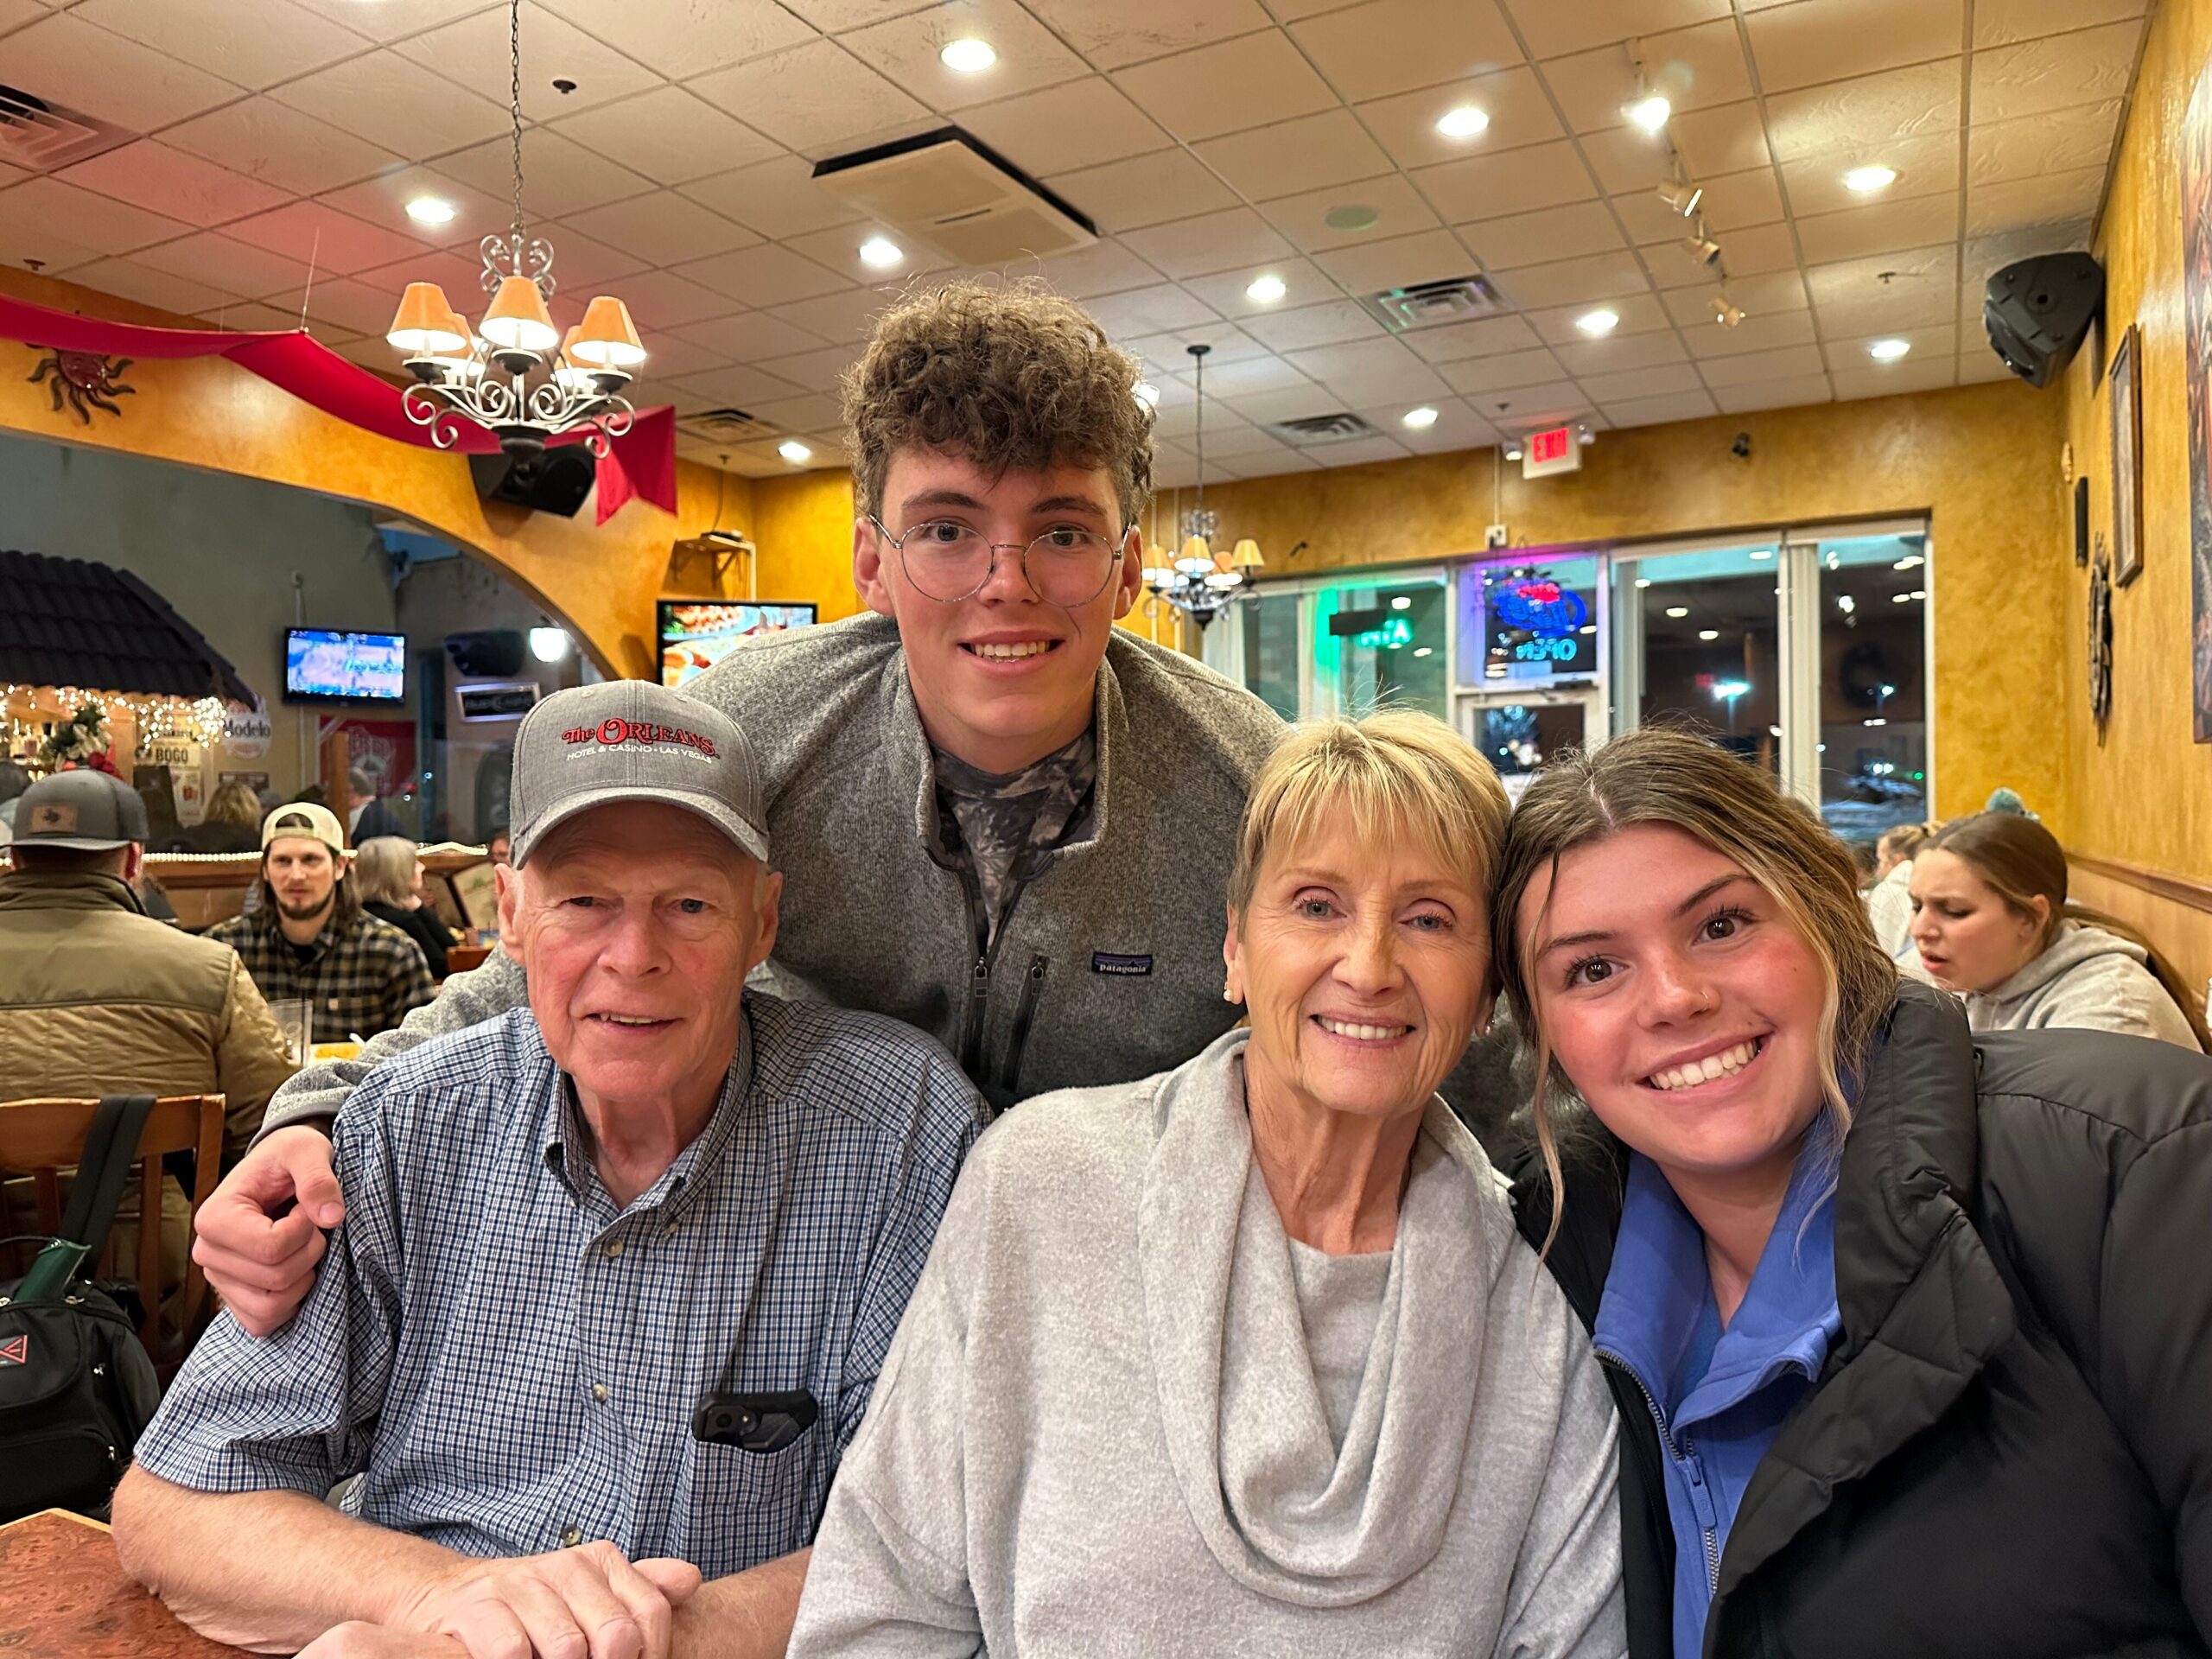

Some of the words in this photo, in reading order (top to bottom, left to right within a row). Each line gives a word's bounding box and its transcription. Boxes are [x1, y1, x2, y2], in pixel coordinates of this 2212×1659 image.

[1533, 428, 1568, 462] EXIT
[223, 719, 270, 739] Modelo
[562, 727, 595, 744] The
[596, 717, 716, 757] ORLEANS
[156, 747, 188, 764] BOGO
[567, 747, 596, 760] HOTEL
[609, 744, 653, 753] CASINO
[659, 747, 678, 755] LAS
[681, 748, 712, 764] VEGAS
